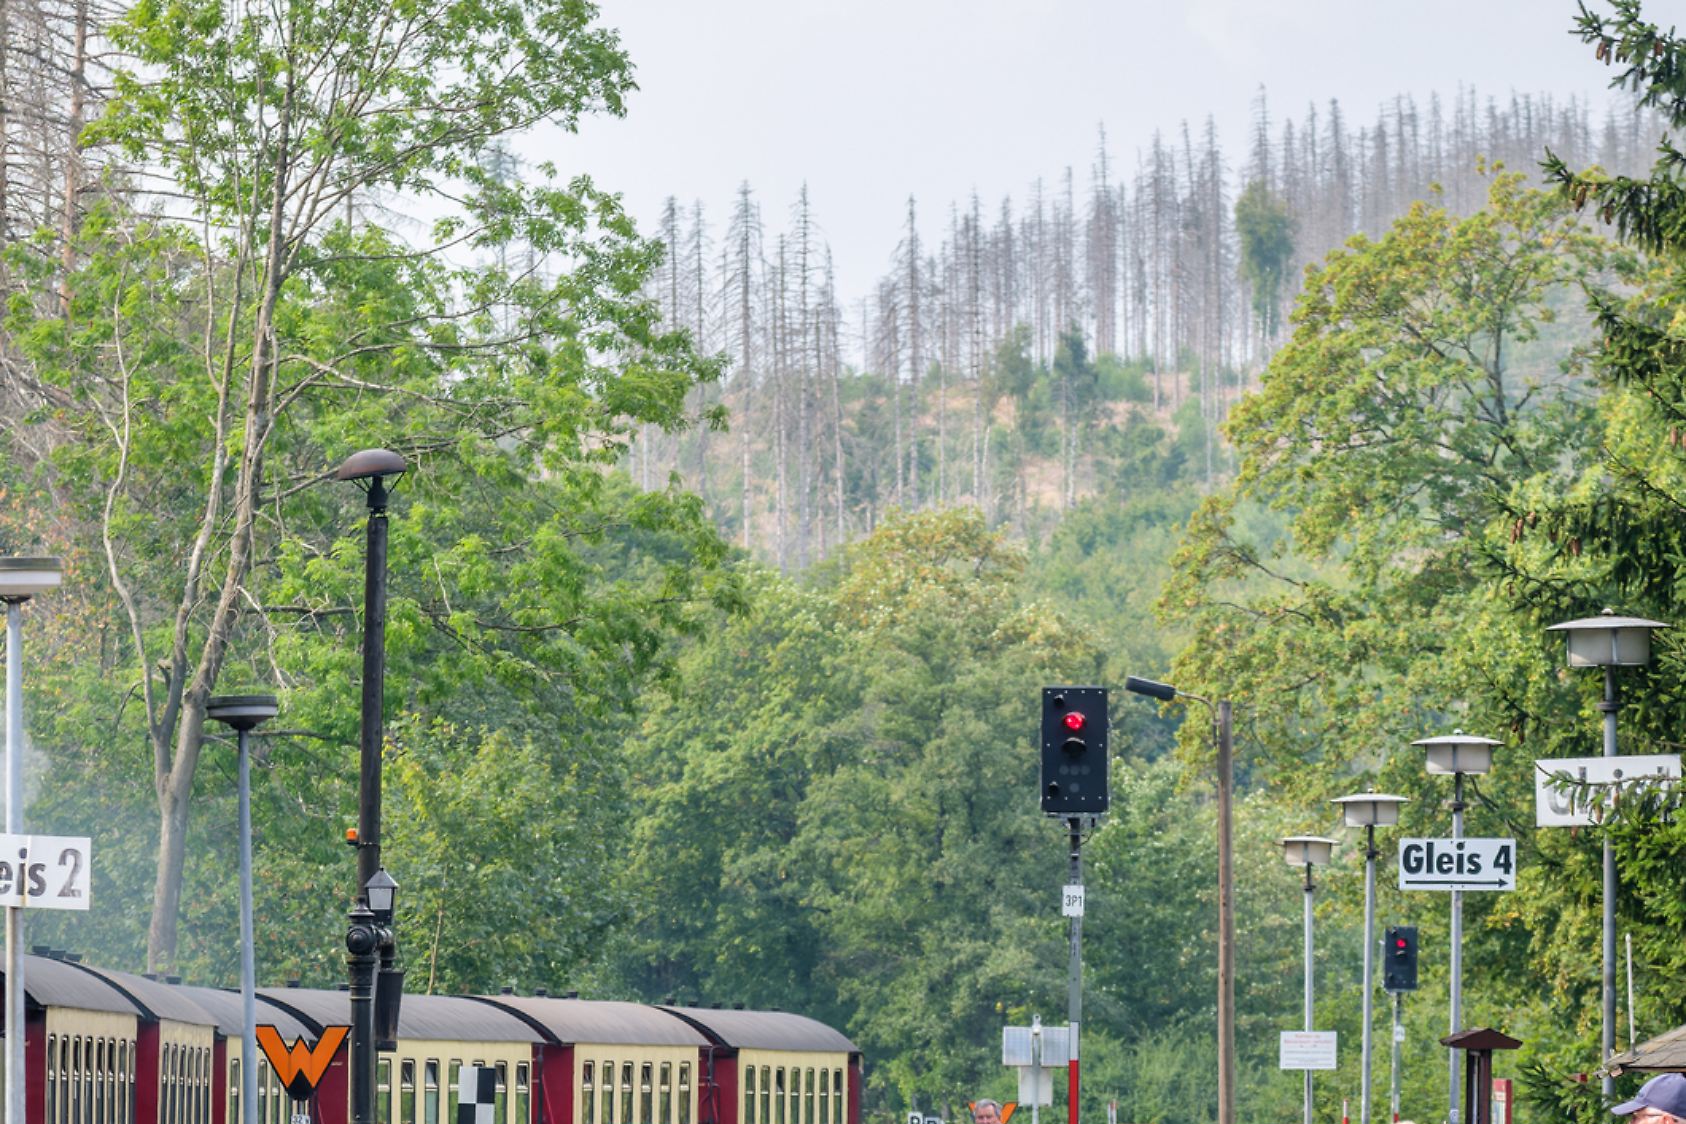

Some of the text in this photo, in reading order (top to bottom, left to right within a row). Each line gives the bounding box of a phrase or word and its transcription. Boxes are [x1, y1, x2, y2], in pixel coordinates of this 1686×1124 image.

[57, 848, 82, 897] 2
[1403, 841, 1512, 875] Gleis 4
[1065, 894, 1082, 907] 3P1
[256, 1024, 352, 1091] W
